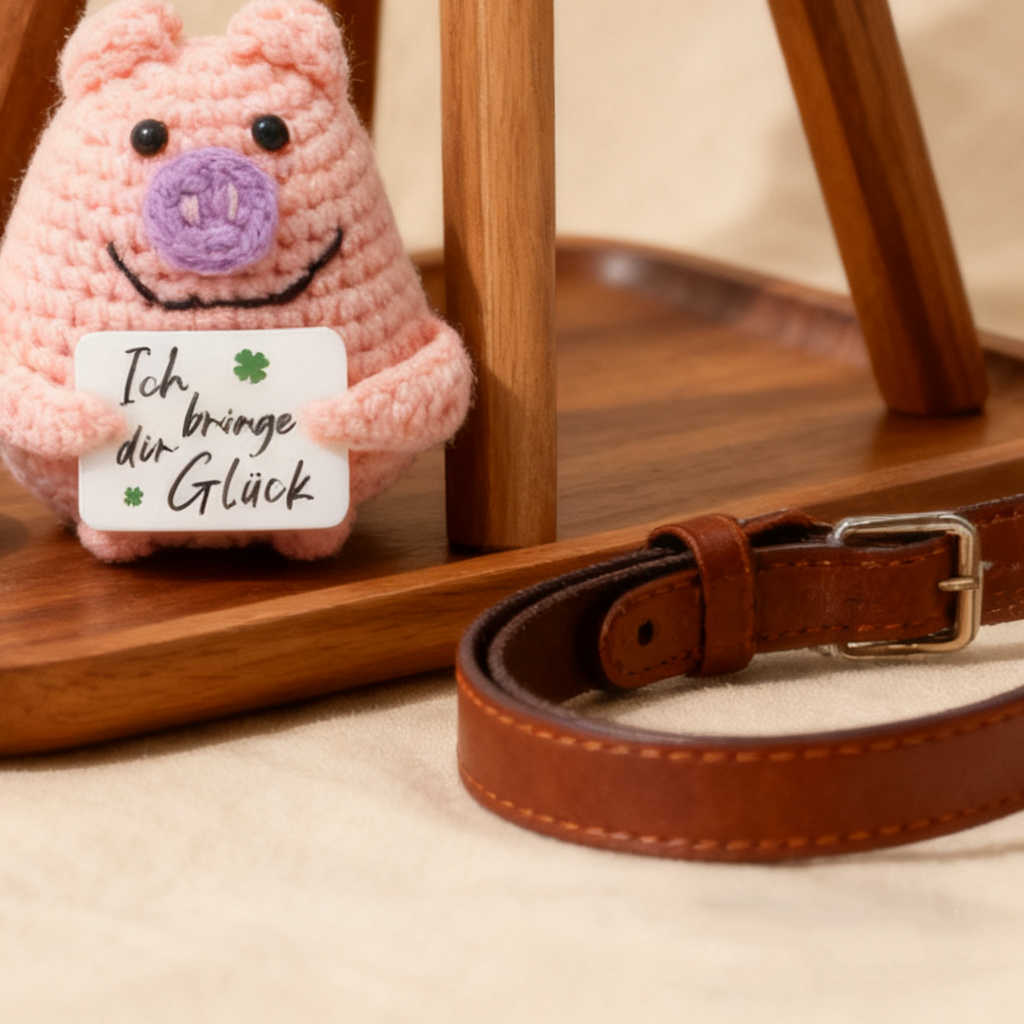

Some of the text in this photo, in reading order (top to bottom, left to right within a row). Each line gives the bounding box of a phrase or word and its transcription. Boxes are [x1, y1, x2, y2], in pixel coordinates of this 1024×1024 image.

[120, 346, 189, 406] Ich
[116, 425, 179, 468] dir
[182, 391, 297, 458] bringe
[167, 451, 314, 515] Glück
